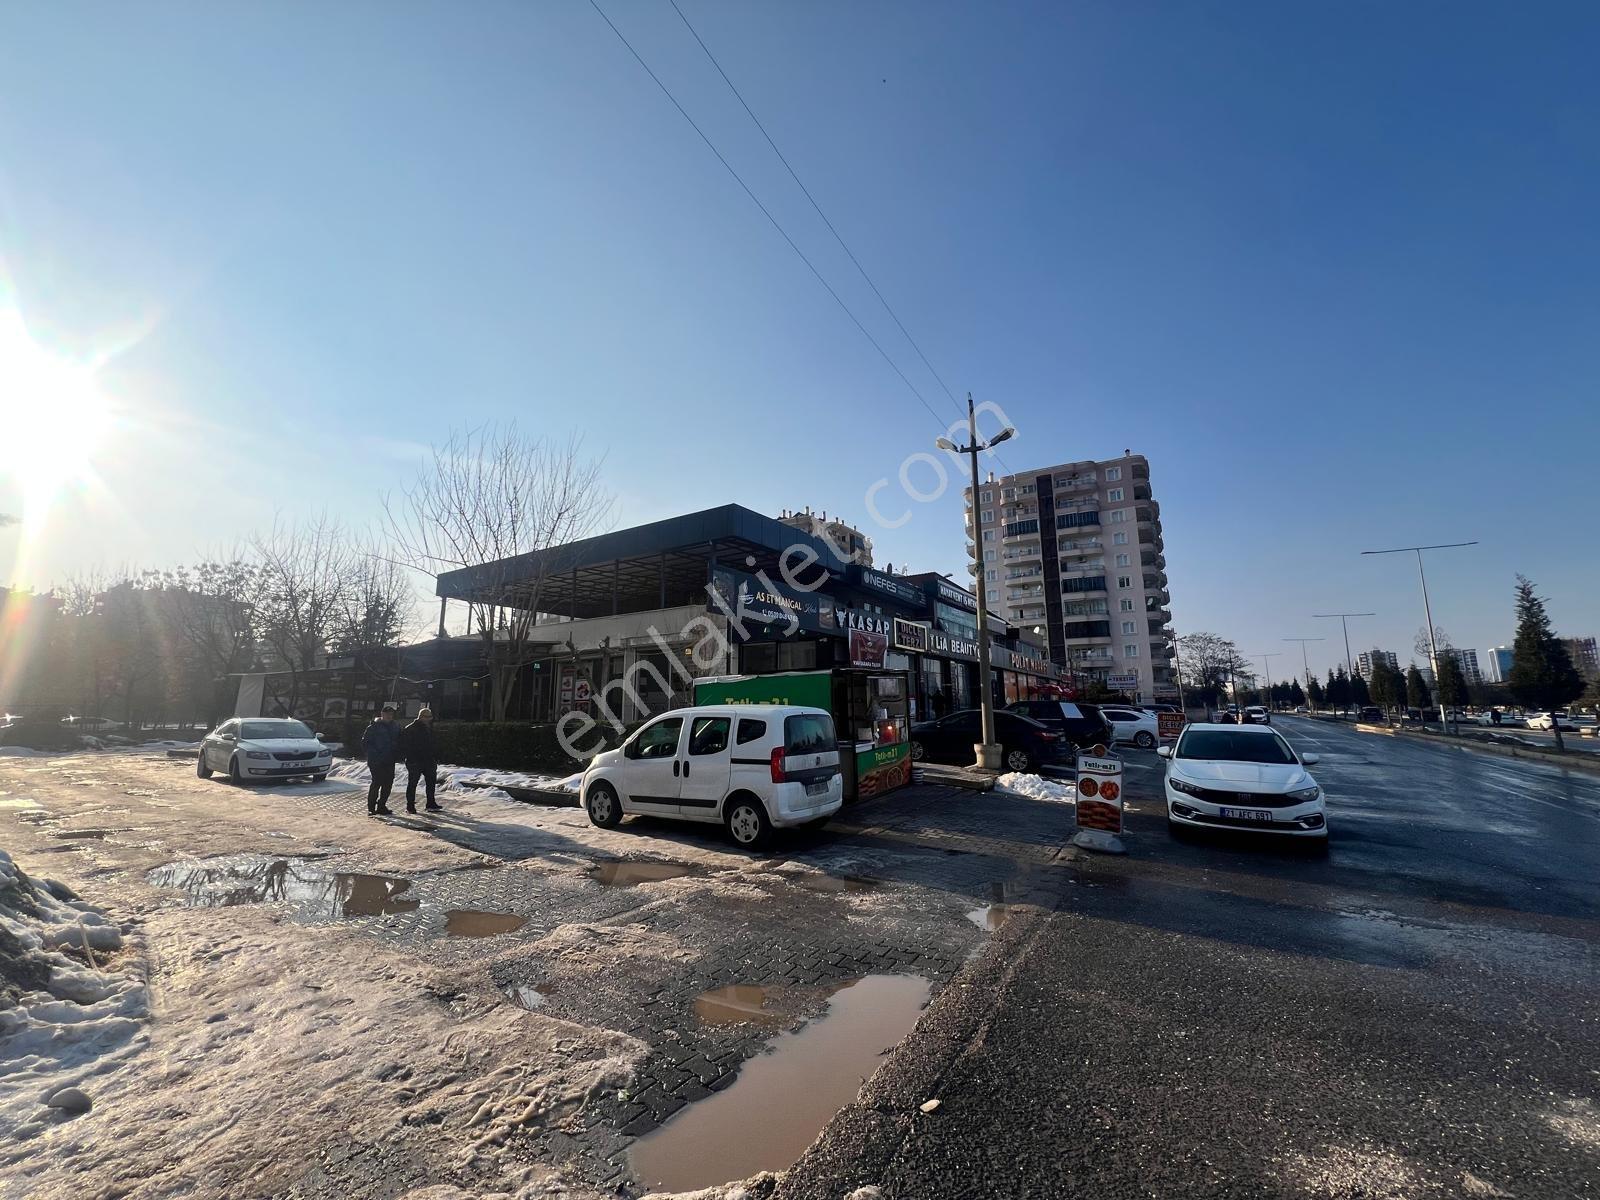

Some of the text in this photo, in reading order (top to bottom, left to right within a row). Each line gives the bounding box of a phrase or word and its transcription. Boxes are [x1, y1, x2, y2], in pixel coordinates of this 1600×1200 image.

[869, 573, 897, 593] NEFES
[755, 591, 765, 602] AS
[766, 593, 774, 604] ET
[774, 595, 802, 611] MANGAL
[849, 611, 890, 636] KASAP
[951, 639, 977, 656] BEAUTY
